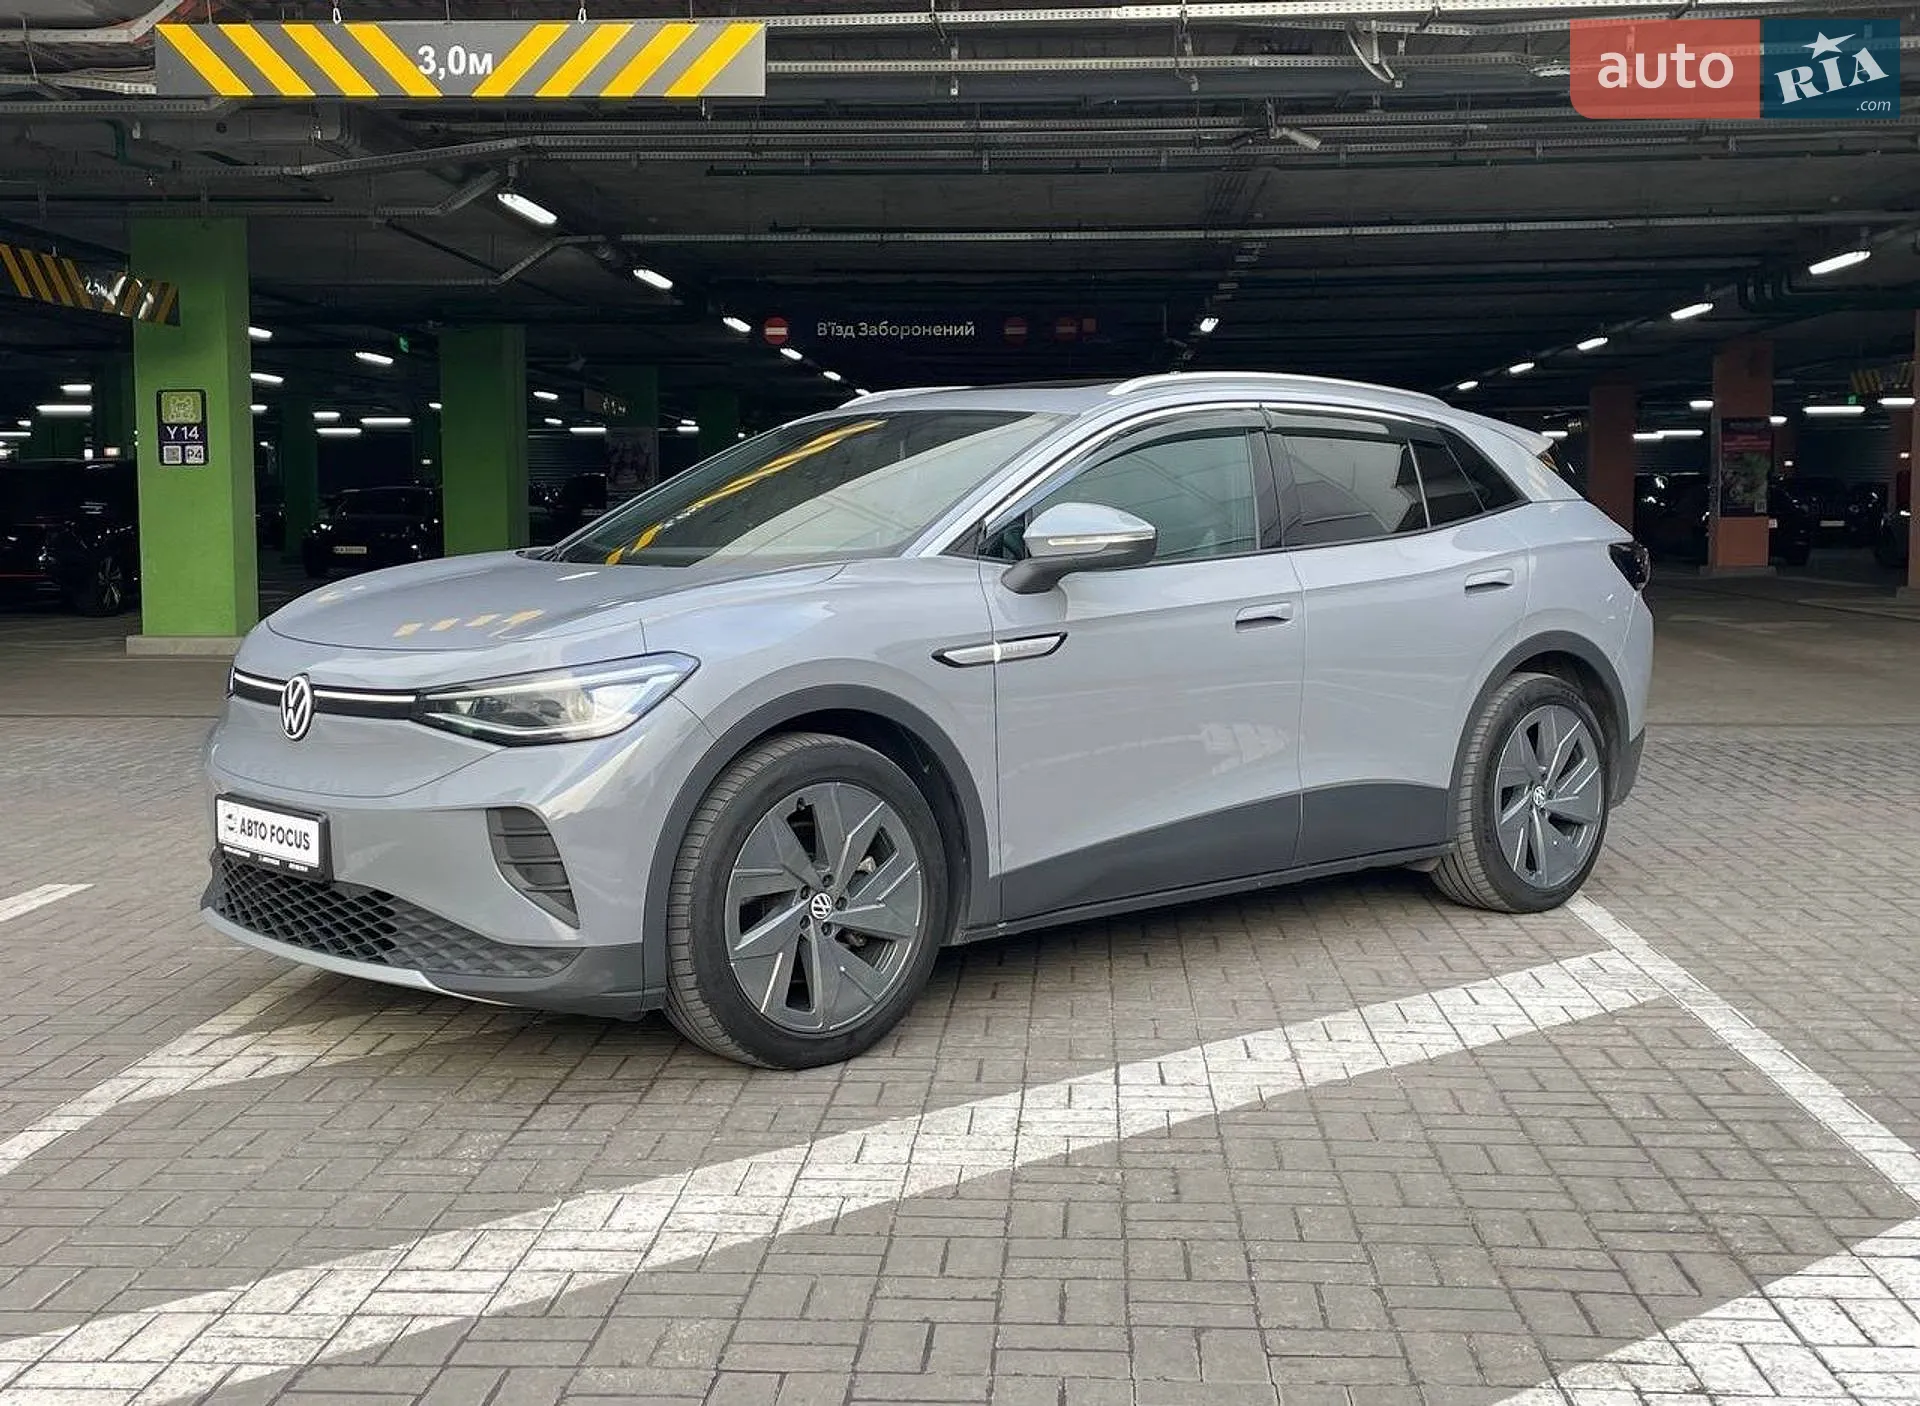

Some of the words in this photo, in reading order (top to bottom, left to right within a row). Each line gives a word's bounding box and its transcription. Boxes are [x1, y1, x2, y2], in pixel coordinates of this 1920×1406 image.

[417, 45, 493, 80] 3,0м
[817, 321, 855, 339] В'їзд
[859, 321, 975, 339] Заборонений
[166, 425, 178, 440] Y
[181, 425, 200, 440] 14
[270, 824, 311, 851] FOCUS
